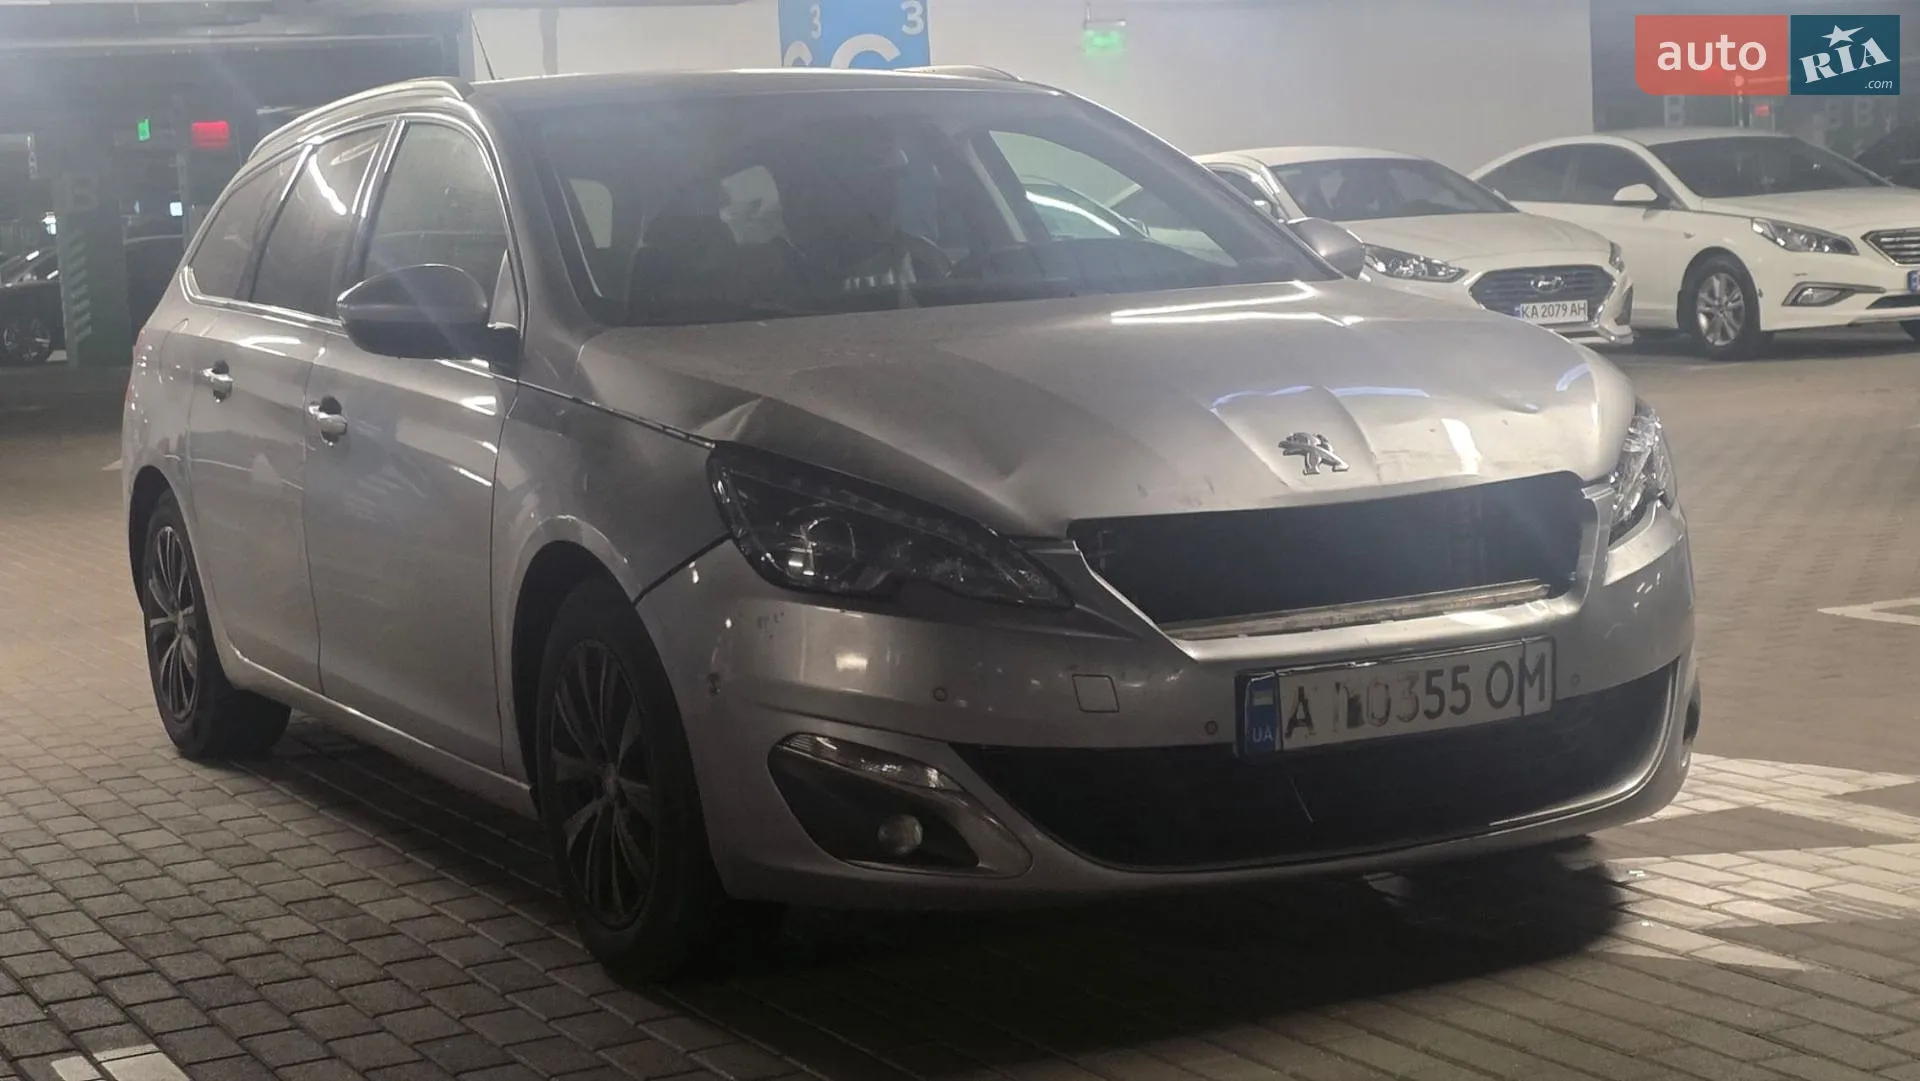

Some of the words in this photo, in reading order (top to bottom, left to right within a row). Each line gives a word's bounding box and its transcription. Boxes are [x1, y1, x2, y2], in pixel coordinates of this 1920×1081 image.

[901, 1, 925, 35] 3
[1522, 305, 1539, 320] KA
[1541, 303, 1568, 319] 2079
[1570, 302, 1587, 317] AH
[1485, 651, 1547, 709] OM
[1252, 727, 1274, 743] UA
